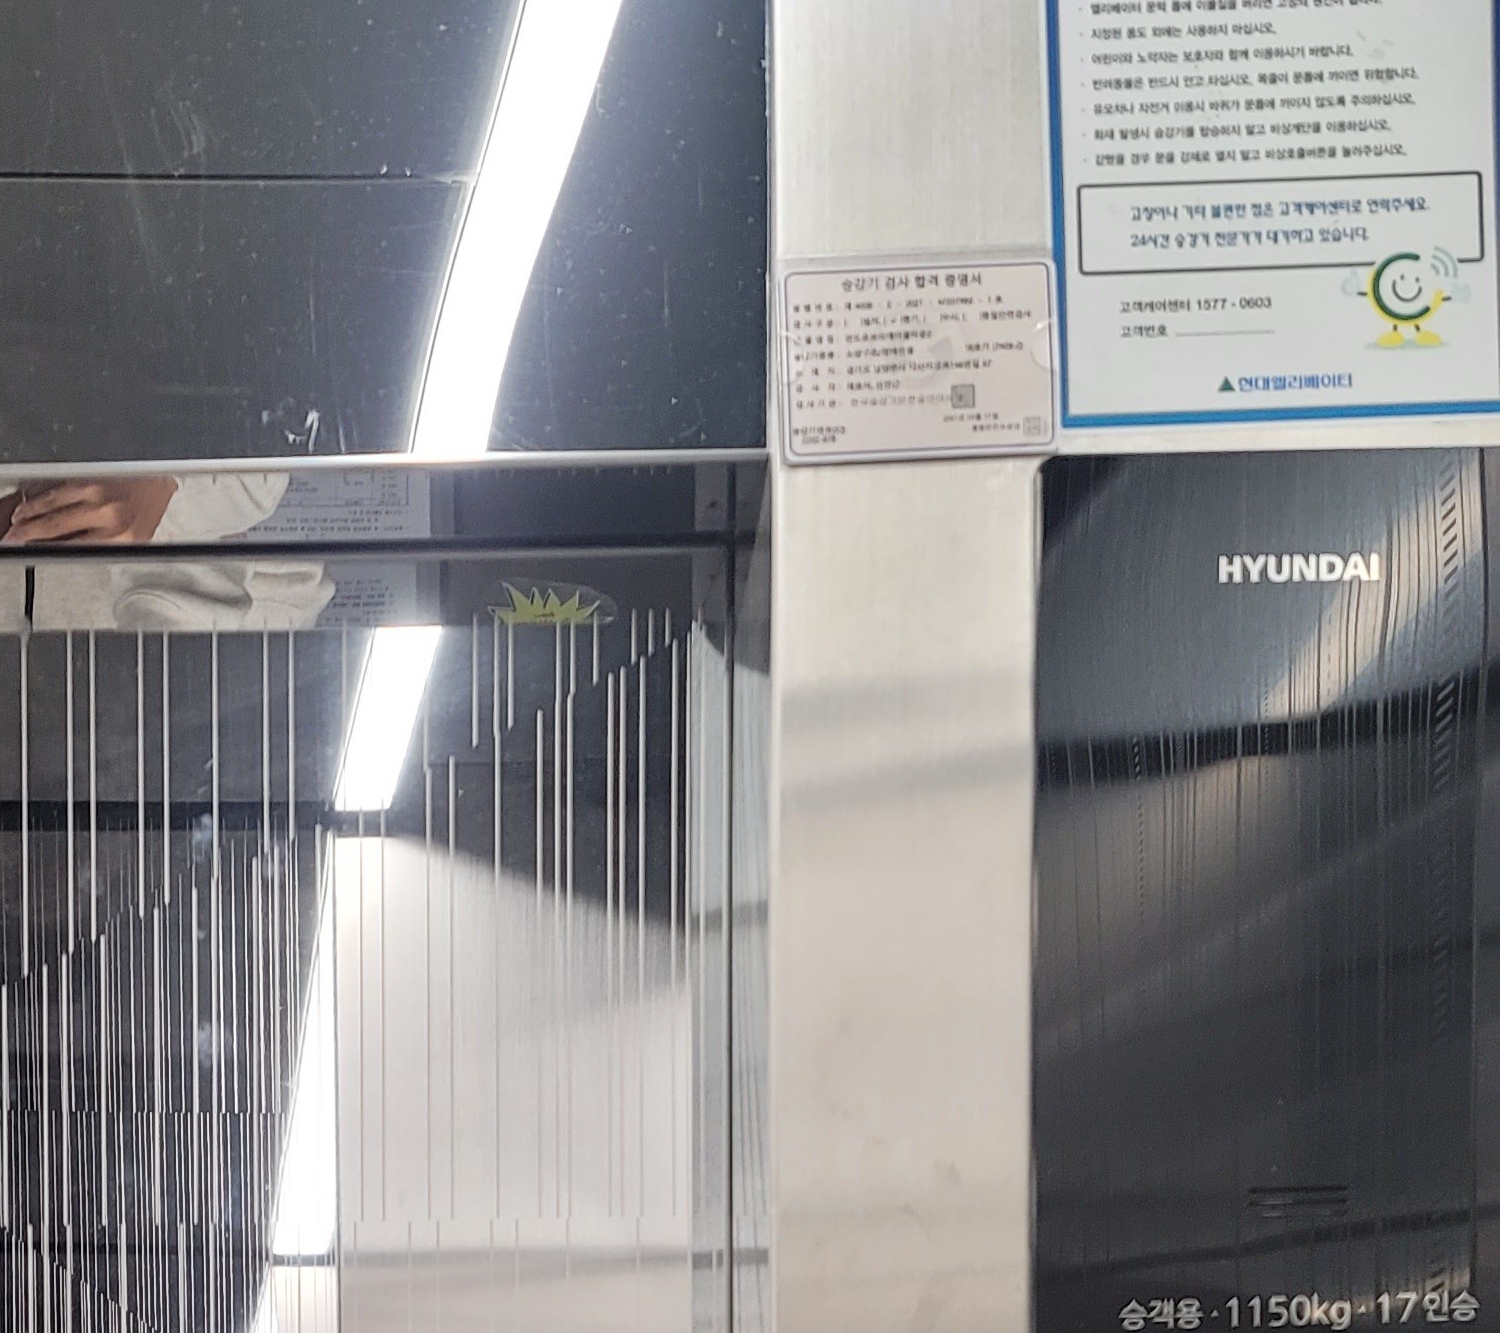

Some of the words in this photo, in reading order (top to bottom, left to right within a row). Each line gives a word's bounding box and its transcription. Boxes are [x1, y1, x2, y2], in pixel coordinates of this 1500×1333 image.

[1197, 298, 1226, 312] 1577
[1239, 296, 1272, 310] 0603
[1238, 372, 1352, 392] 현대엘리베이터
[1217, 551, 1380, 584] HYUNDAI
[1119, 1298, 1204, 1332] 승객용
[1224, 1294, 1353, 1328] 1150kg
[1375, 1291, 1480, 1325] 17인승
